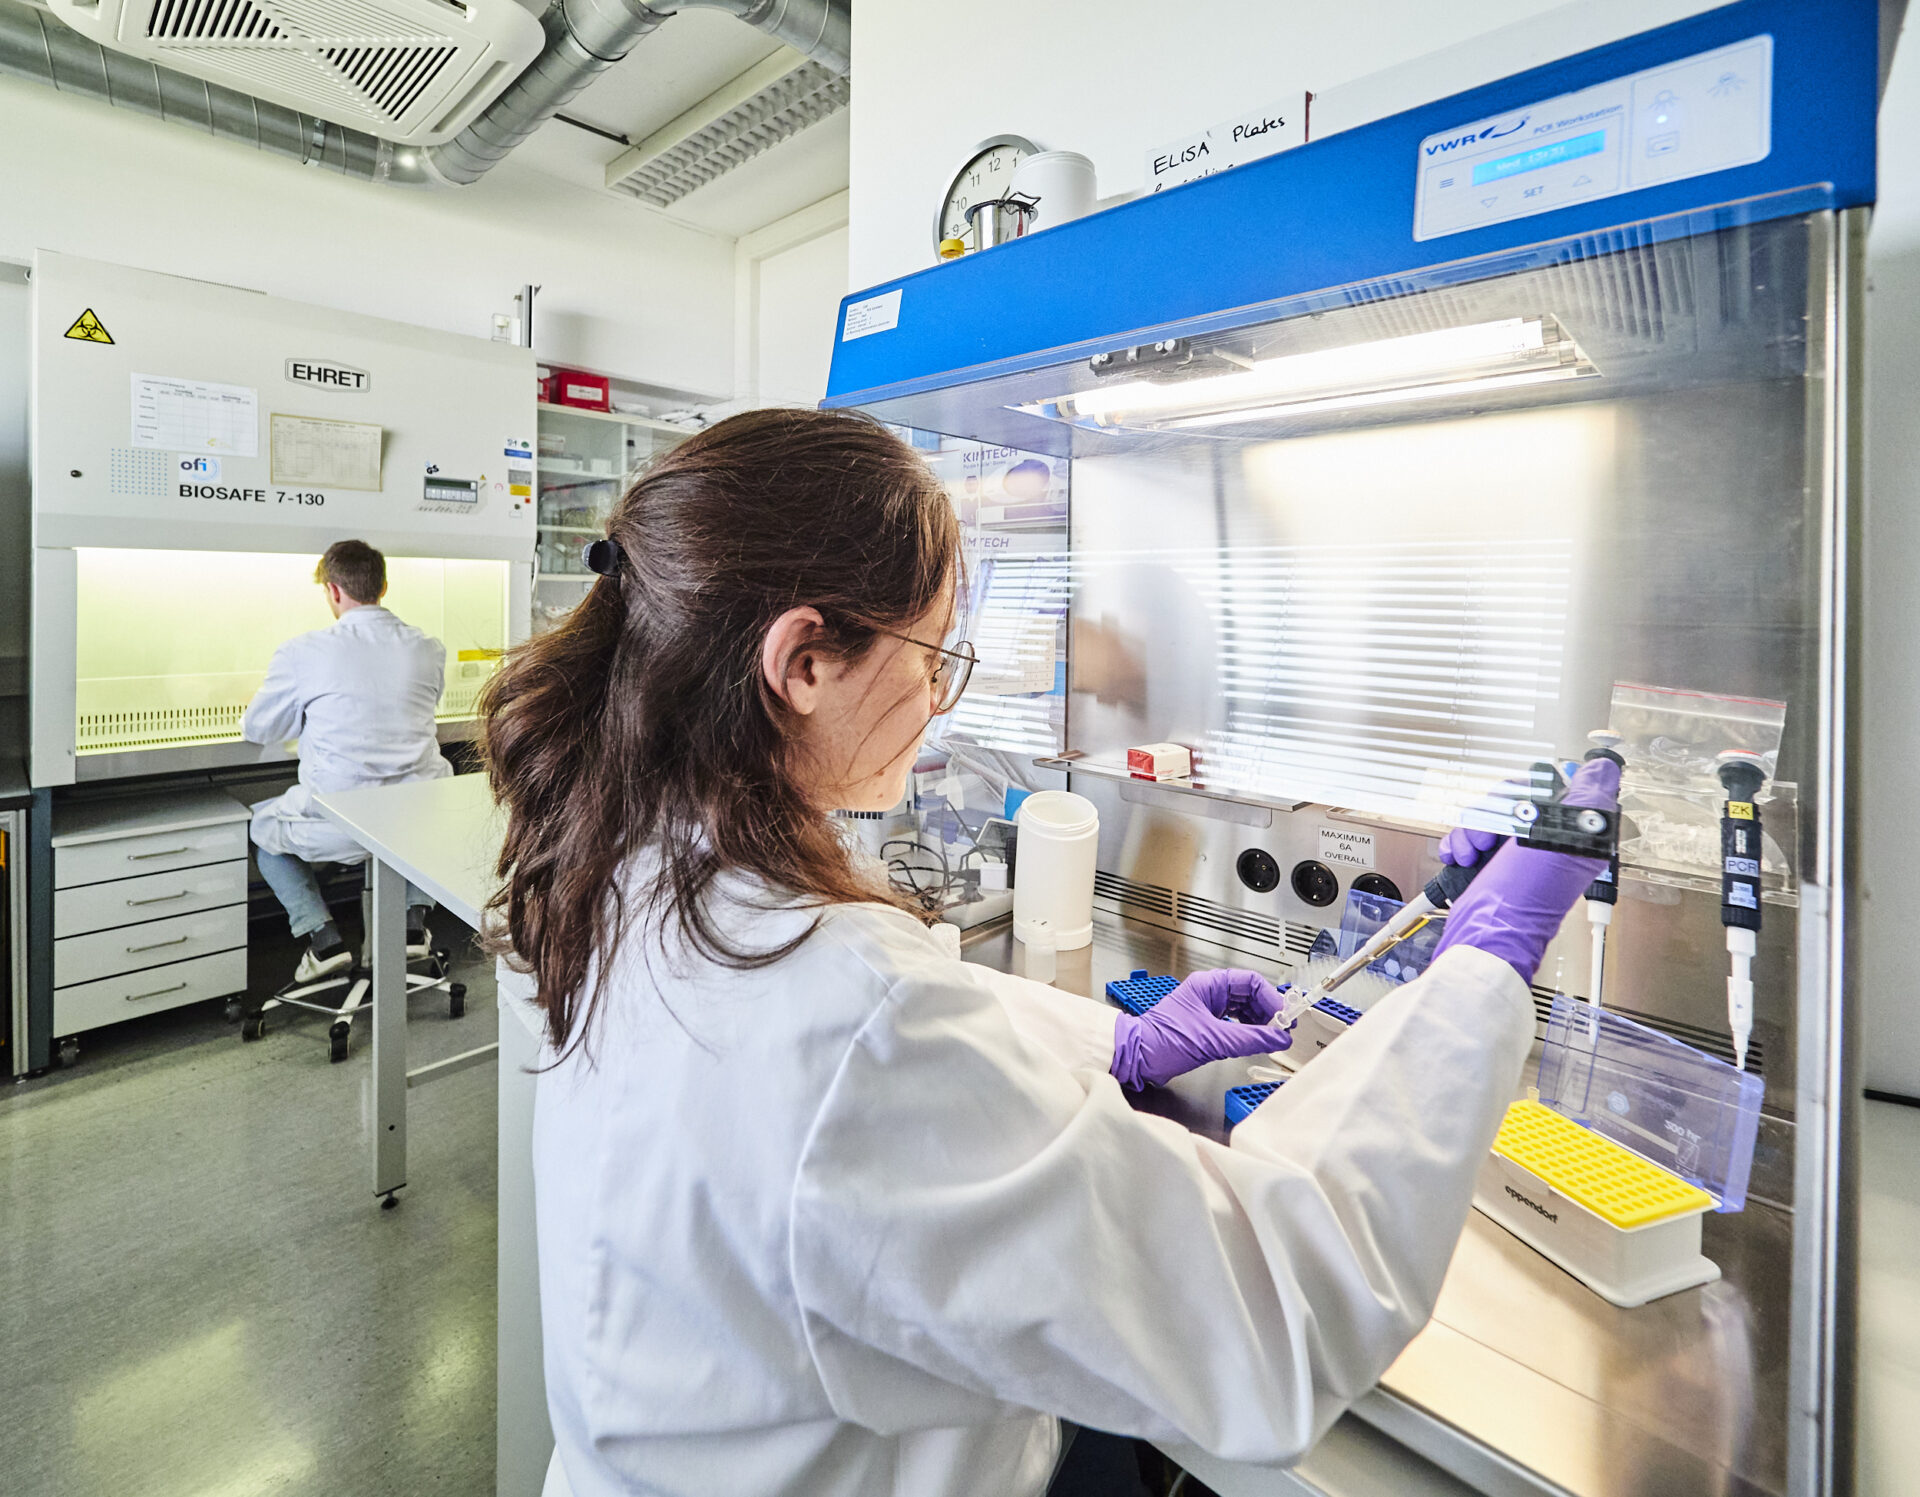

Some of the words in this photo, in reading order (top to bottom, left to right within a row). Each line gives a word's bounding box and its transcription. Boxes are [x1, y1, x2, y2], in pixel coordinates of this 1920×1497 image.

[1556, 104, 1623, 128] Workstation
[1154, 142, 1210, 175] ELISA
[1232, 117, 1286, 142] Plates
[1426, 134, 1476, 156] VWR
[988, 157, 1001, 172] 12
[1012, 157, 1018, 168] 1
[971, 174, 980, 187] 11
[1523, 186, 1544, 199] SET
[956, 197, 967, 211] 10
[952, 224, 960, 236] 9
[293, 363, 365, 388] EHRET
[180, 457, 207, 472] ofi
[179, 484, 266, 502] BIOSAFE
[276, 491, 325, 506] 7-130
[1732, 804, 1750, 816] ZK
[1321, 830, 1371, 844] MAXIMUM
[1339, 842, 1352, 852] 6A
[1324, 851, 1367, 865] OVERALL
[1728, 860, 1758, 874] PCR
[1505, 1186, 1558, 1224] eppendorf
